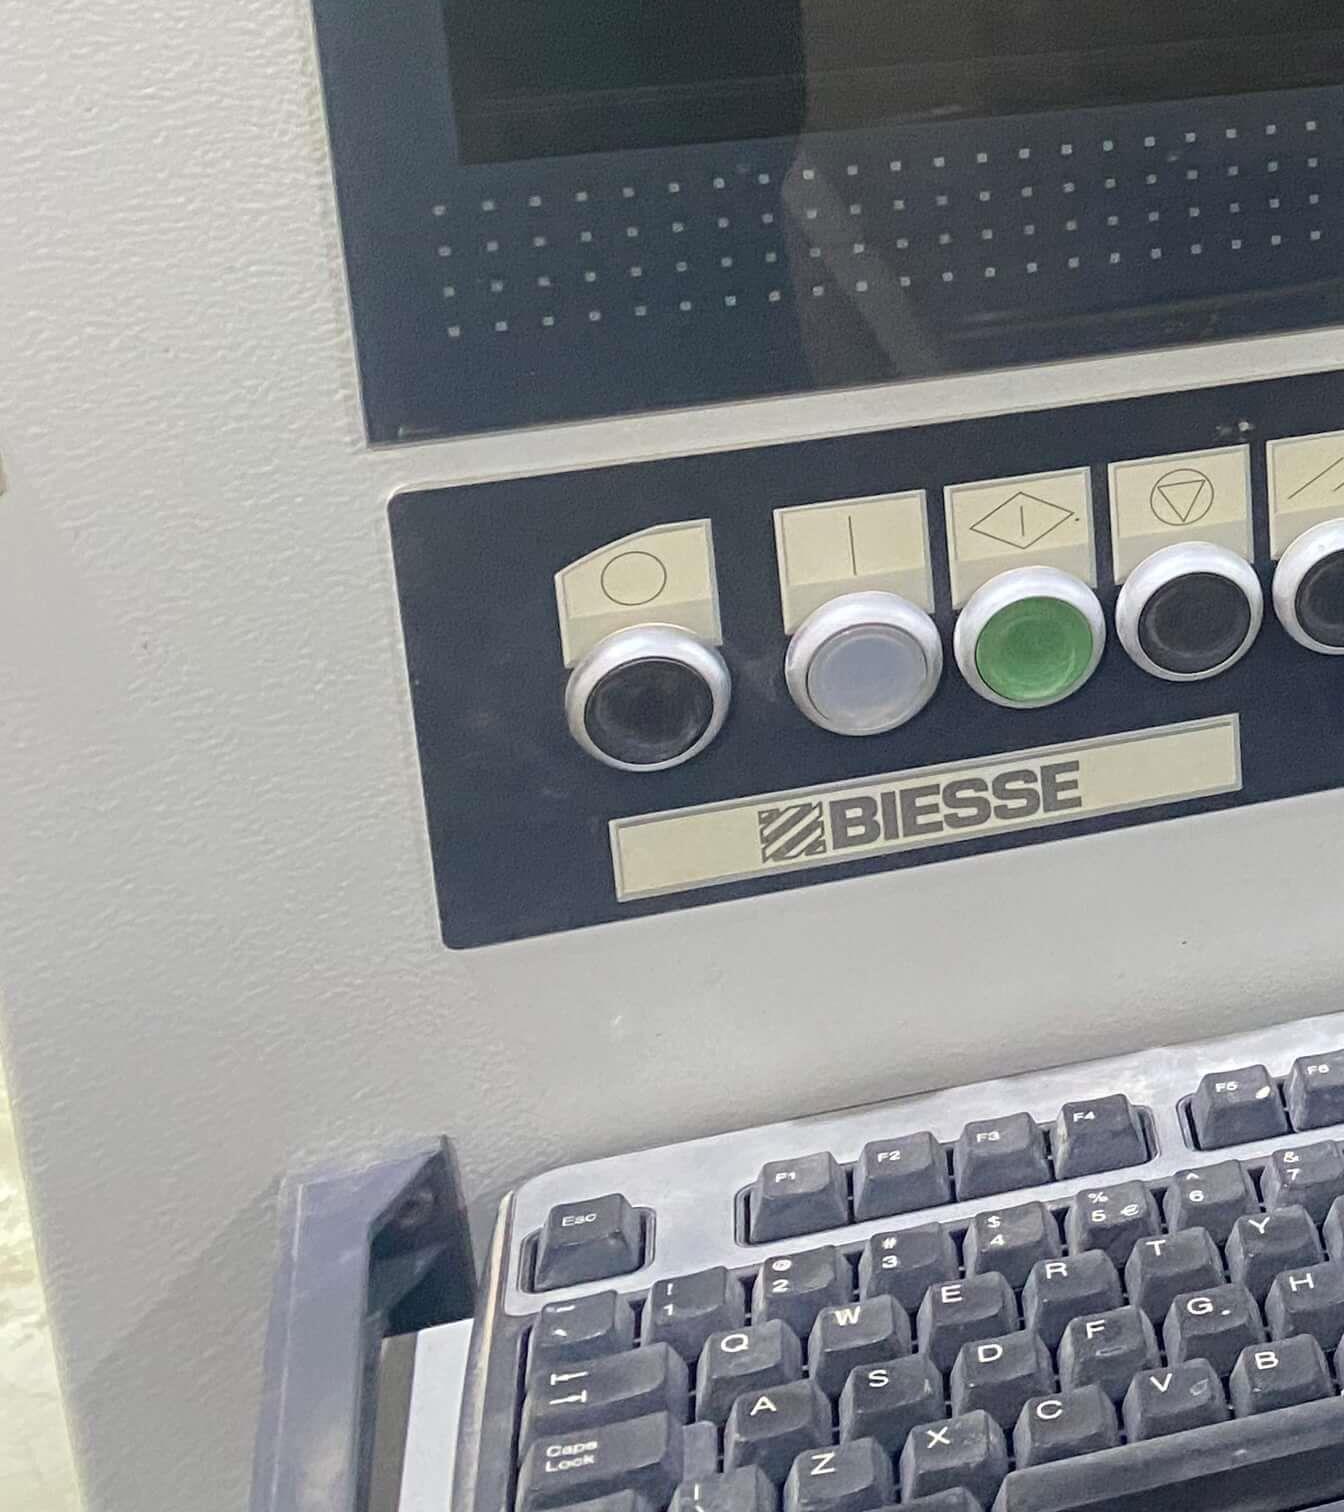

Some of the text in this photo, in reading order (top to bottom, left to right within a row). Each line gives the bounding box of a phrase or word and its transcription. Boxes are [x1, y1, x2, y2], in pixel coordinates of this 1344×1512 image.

[829, 760, 1082, 850] BIESSE
[1307, 1063, 1330, 1076] F6
[1215, 1081, 1239, 1093] F5
[1073, 1111, 1096, 1122] F4
[976, 1130, 1001, 1143] F3
[877, 1150, 901, 1163] F2
[775, 1171, 797, 1184] F1
[1286, 1168, 1301, 1181] 7
[1188, 1189, 1205, 1202] 6
[561, 1213, 597, 1227] Esc
[1091, 1209, 1107, 1222] 5
[1247, 1216, 1271, 1234] Y
[989, 1233, 1006, 1246] 4
[1145, 1239, 1167, 1256] T
[881, 1255, 899, 1269] 3
[1044, 1262, 1068, 1280] R
[772, 1279, 789, 1293] 2
[1288, 1272, 1315, 1292] H
[940, 1284, 963, 1303] E
[663, 1303, 674, 1316] 1
[1186, 1297, 1214, 1315] G
[833, 1305, 861, 1326] W
[1085, 1319, 1105, 1339] F
[720, 1333, 749, 1353] Q
[977, 1343, 1003, 1363] D
[1254, 1351, 1279, 1370] B
[868, 1369, 889, 1388] S
[1149, 1372, 1173, 1393] V
[750, 1396, 777, 1416] A
[1036, 1399, 1063, 1420] C
[926, 1426, 951, 1449] X
[546, 1441, 598, 1458] Caps
[545, 1454, 595, 1473] Lock
[810, 1451, 836, 1476] Z
